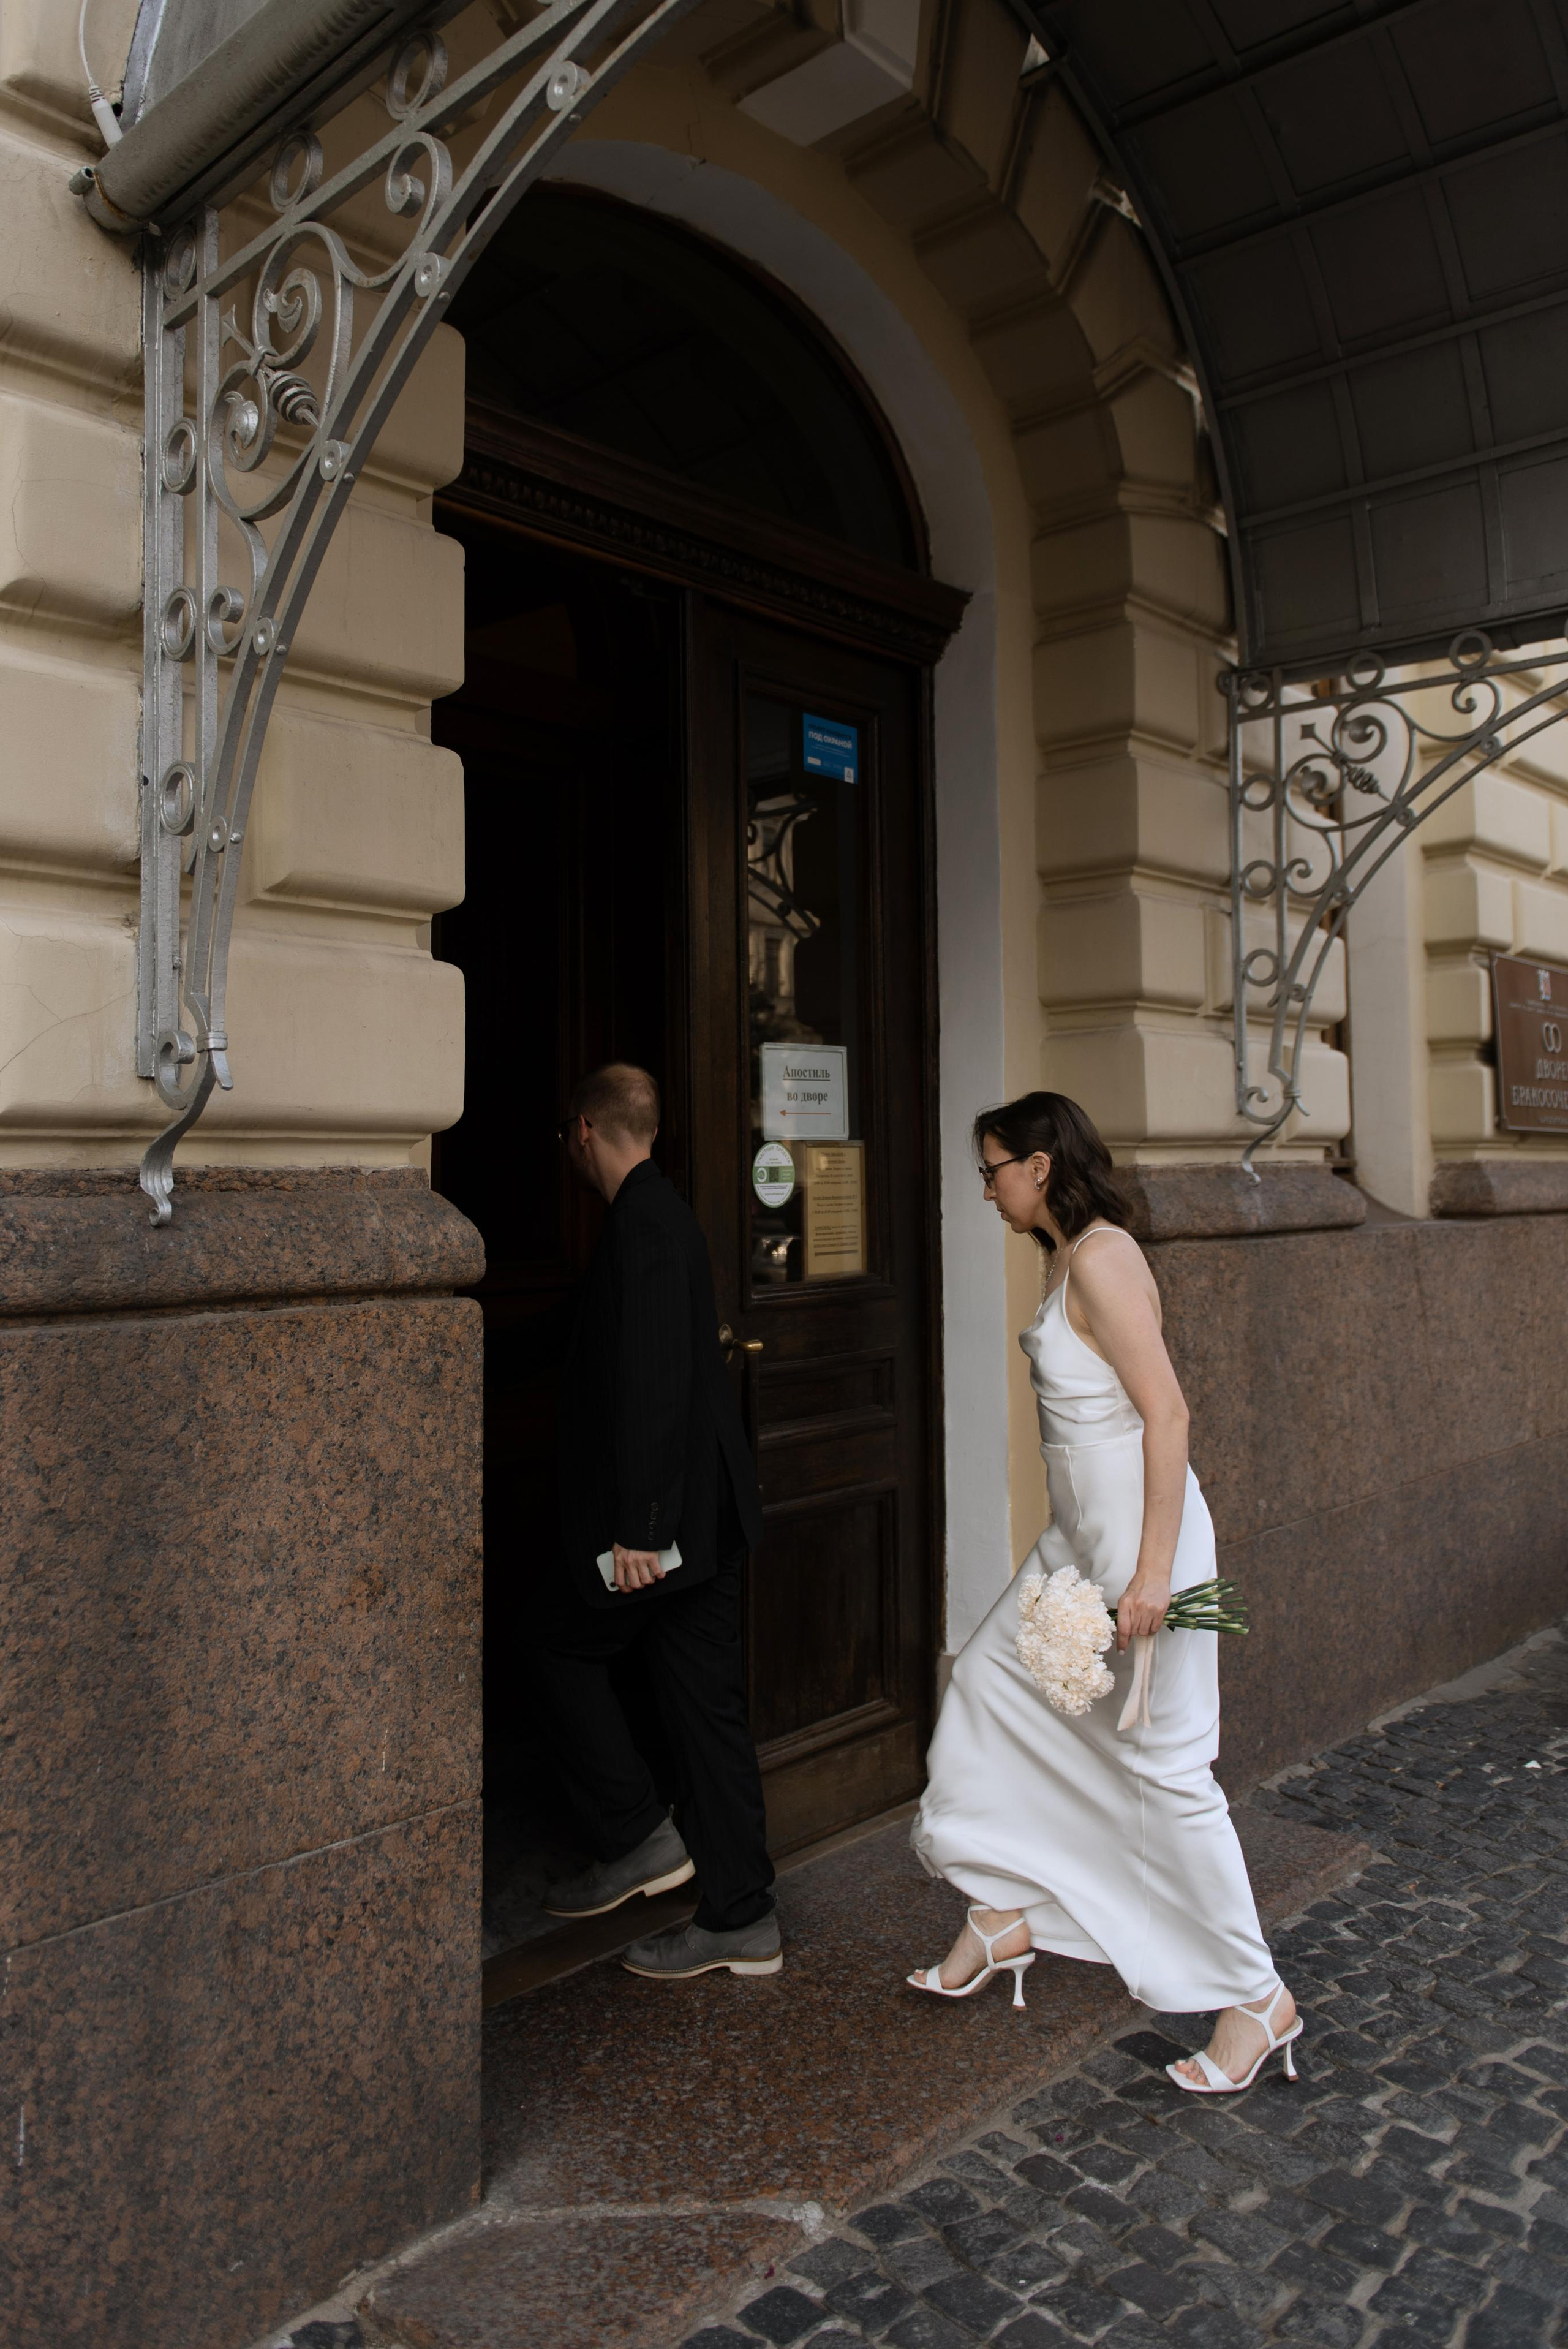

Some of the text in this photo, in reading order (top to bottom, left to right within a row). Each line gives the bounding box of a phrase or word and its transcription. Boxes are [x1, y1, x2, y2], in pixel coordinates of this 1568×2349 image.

[809, 730, 823, 743] ПОД
[823, 735, 853, 749] ОХРАНОЙ
[783, 1065, 831, 1078] Апостиль
[1536, 1058, 1568, 1081] ДВОРЕ
[787, 1092, 828, 1105] во дворе
[756, 1146, 791, 1165] УЧАСТНИК ПРОЕКТА
